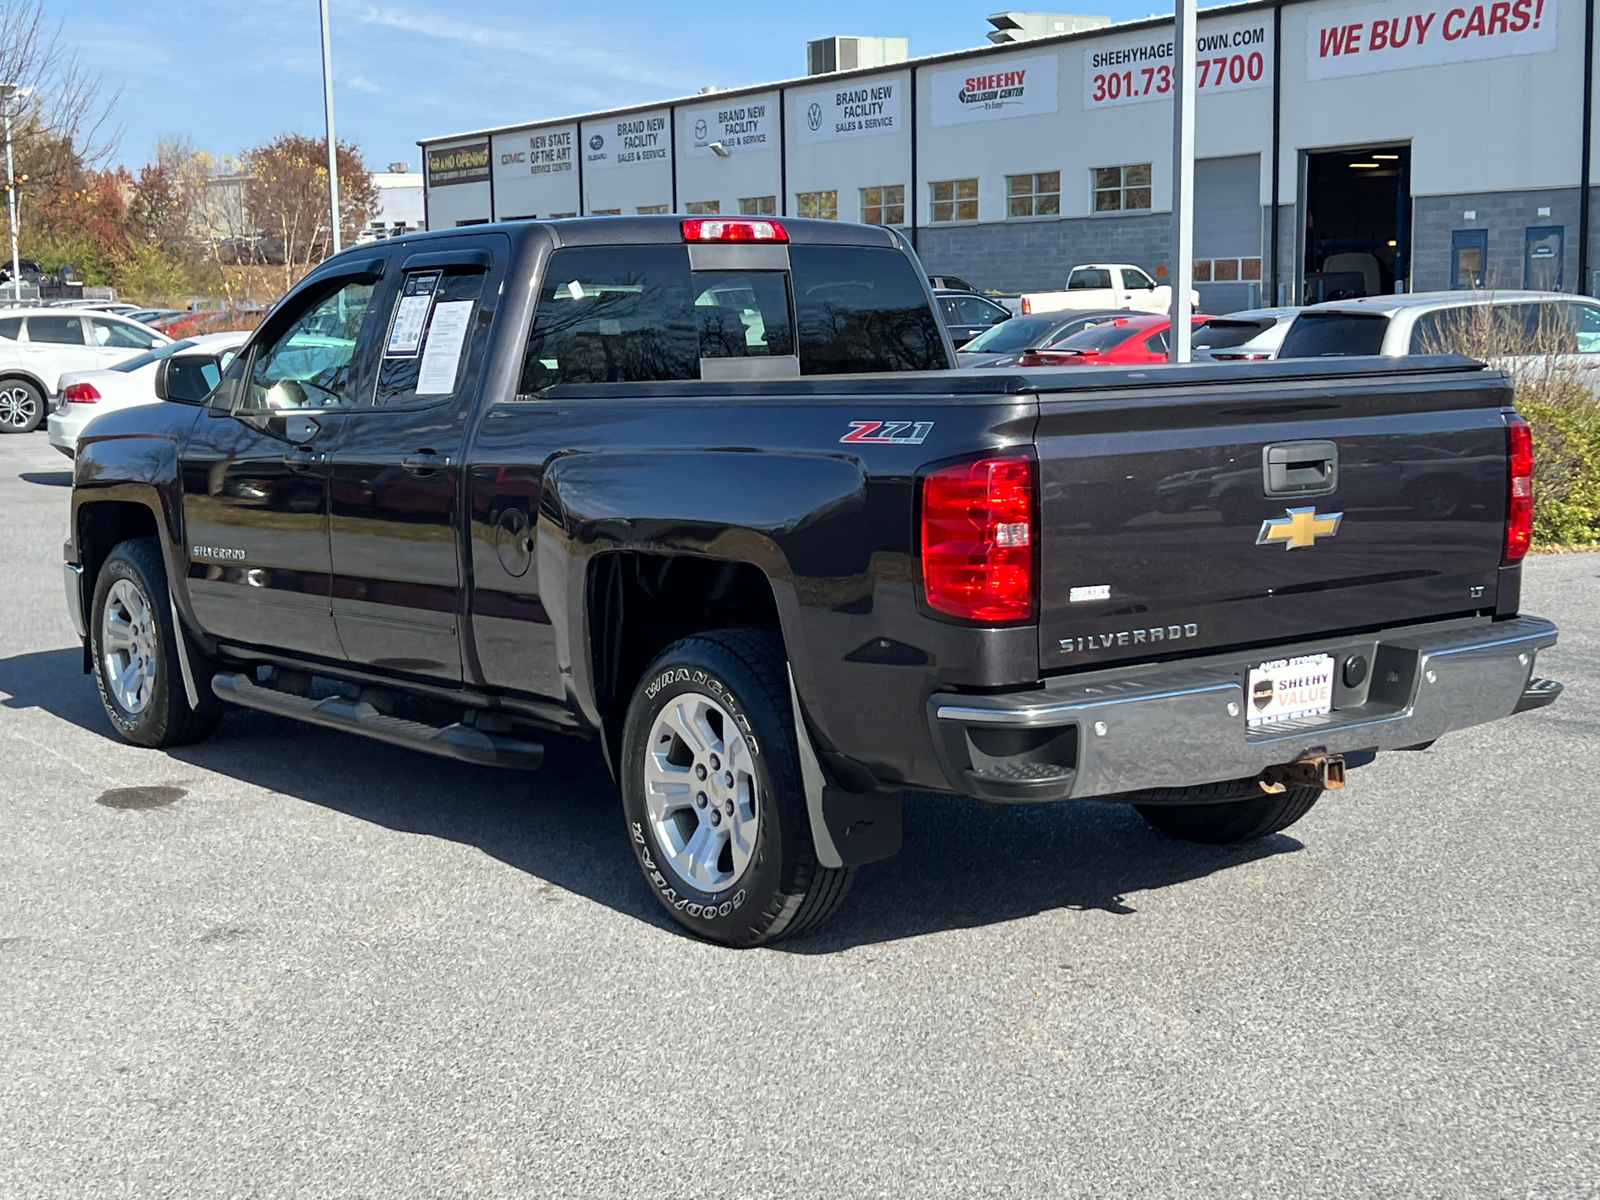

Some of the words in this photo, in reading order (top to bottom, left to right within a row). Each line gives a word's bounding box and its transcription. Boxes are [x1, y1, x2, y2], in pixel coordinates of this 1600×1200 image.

[1319, 23, 1364, 58] WE
[1369, 13, 1436, 51] BUY
[1442, 0, 1545, 41] CARS!
[965, 70, 1026, 93] SHEEHY
[836, 89, 868, 106] BRAND
[870, 86, 892, 101] NEW
[965, 89, 999, 104] COLLISION
[999, 87, 1025, 100] CENTER
[718, 109, 746, 124] BRAND
[749, 106, 766, 119] NEW
[844, 101, 884, 119] FACILITY
[617, 120, 645, 136] BRAND
[646, 118, 665, 132] NEW
[725, 120, 758, 135] FACILITY
[835, 121, 856, 132] SALES
[857, 120, 863, 129] &
[864, 116, 893, 129] SERVICE
[530, 136, 548, 150] NEW
[548, 132, 571, 147] STATE
[624, 133, 658, 149] FACILITY
[736, 136, 741, 145] &
[742, 134, 766, 144] SERVICE
[429, 154, 455, 172] GRAND
[456, 151, 488, 169] OPENING
[501, 152, 526, 165] GMC
[530, 151, 540, 164] OF
[541, 149, 554, 163] THE
[556, 147, 572, 160] ART
[617, 152, 635, 163] SALES
[636, 151, 641, 161] &
[642, 148, 666, 160] SERVICE
[531, 164, 551, 174] SERVICE
[552, 162, 572, 172] CENTER
[839, 421, 935, 445] Z71
[193, 545, 246, 560] SILVERADO
[1470, 586, 1485, 598] LT
[1059, 623, 1198, 654] SILVERADO
[1278, 673, 1329, 690] SHEEHY
[1278, 686, 1328, 707] VALUE
[645, 668, 760, 756] WRANGLER
[631, 822, 747, 920] GOODYEAR
